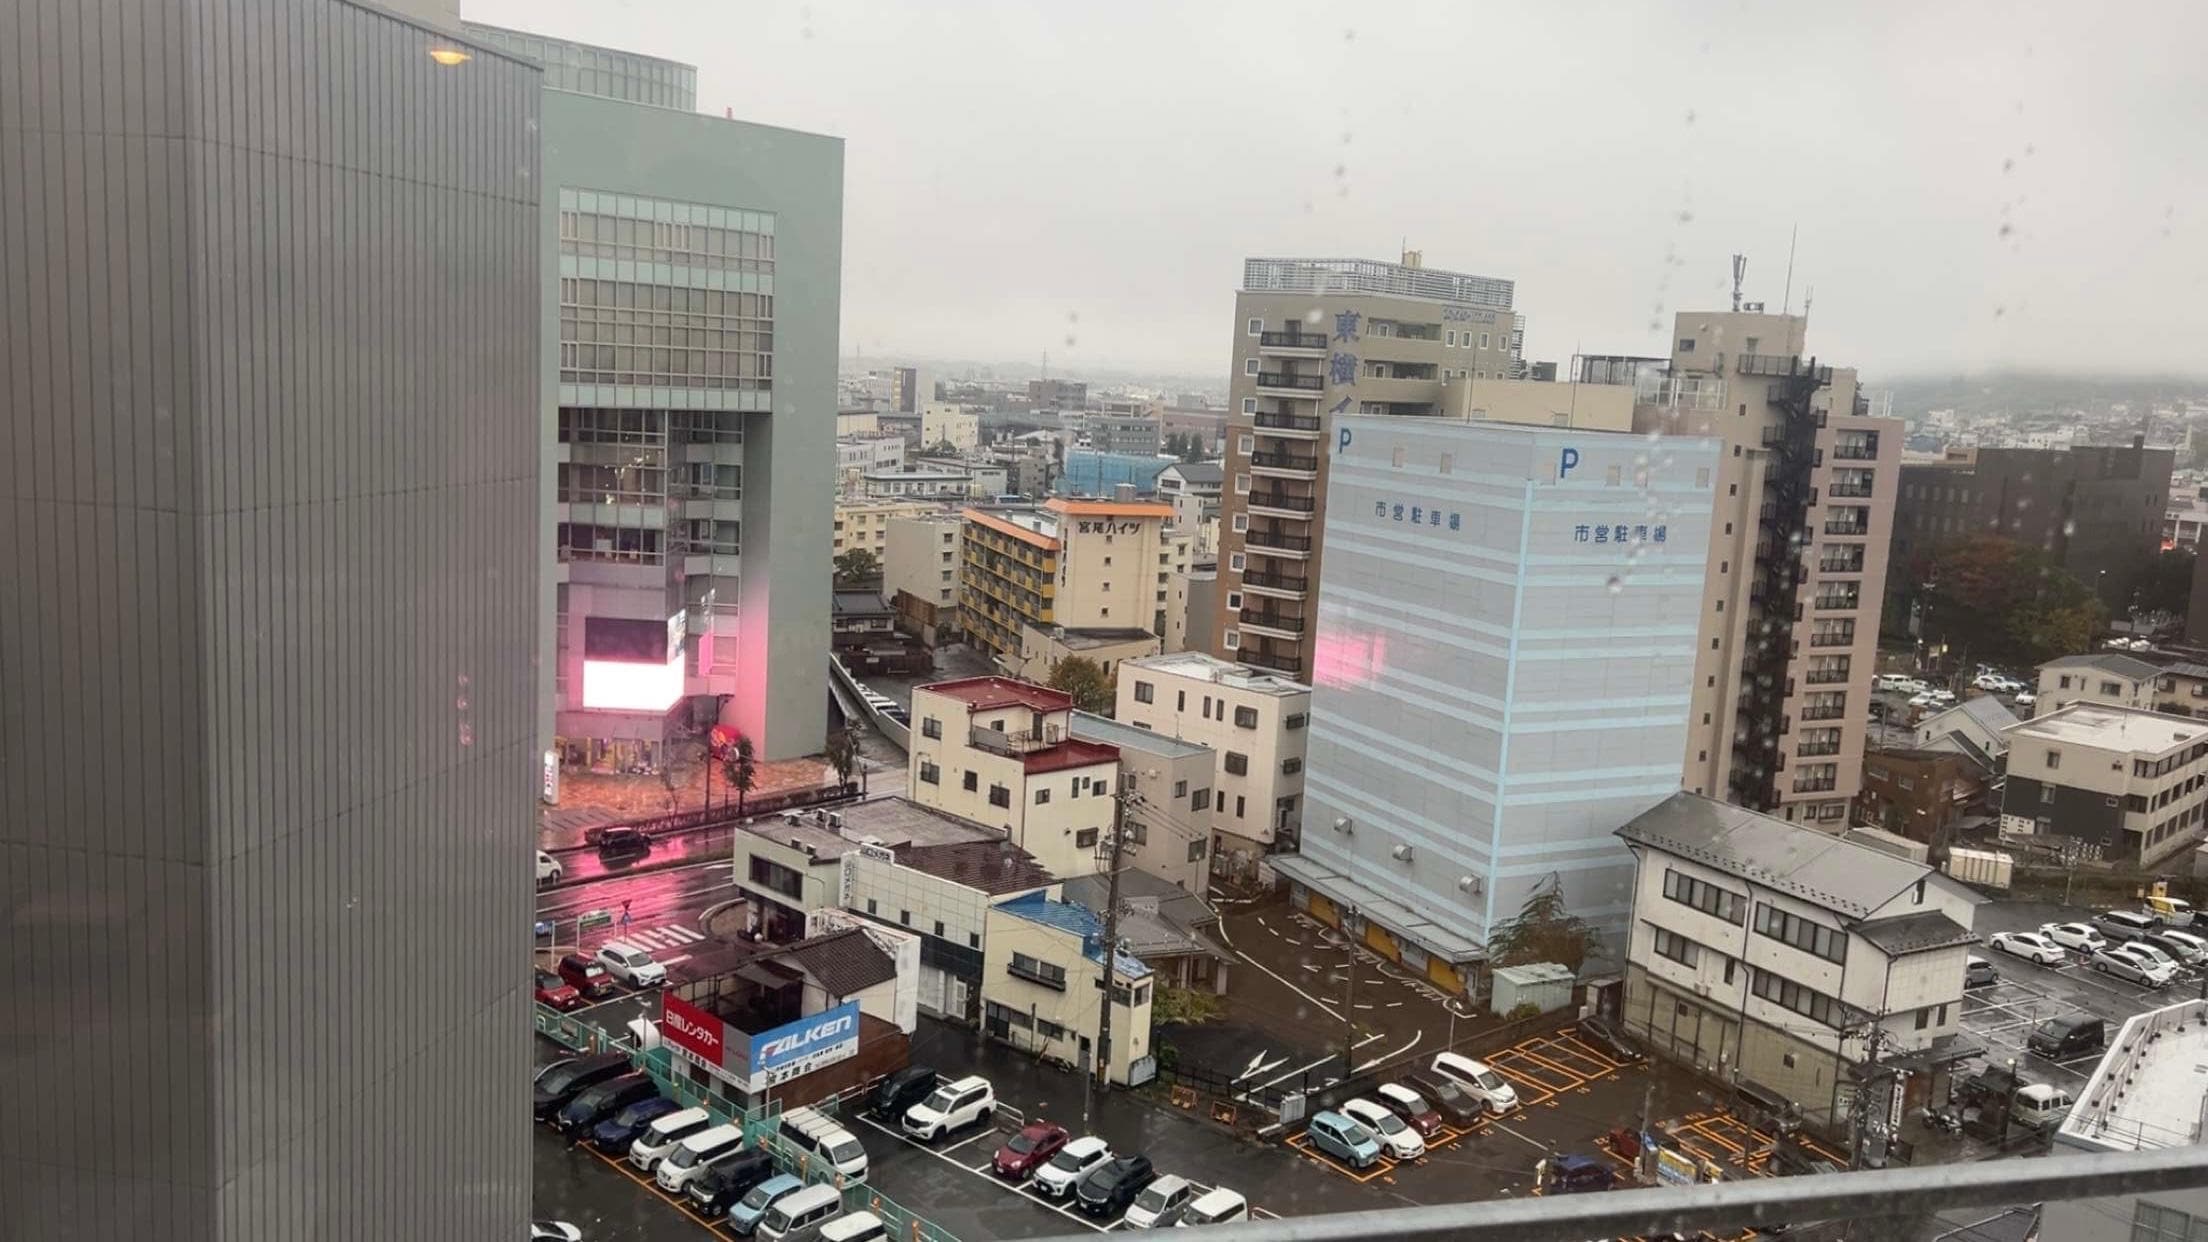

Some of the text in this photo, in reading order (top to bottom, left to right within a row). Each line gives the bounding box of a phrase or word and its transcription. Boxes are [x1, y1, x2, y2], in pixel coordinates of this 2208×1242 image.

[1338, 428, 1352, 455] P
[1560, 448, 1579, 479] P
[1375, 501, 1461, 531] 市営駐車場
[760, 1015, 852, 1061] FALKEN
